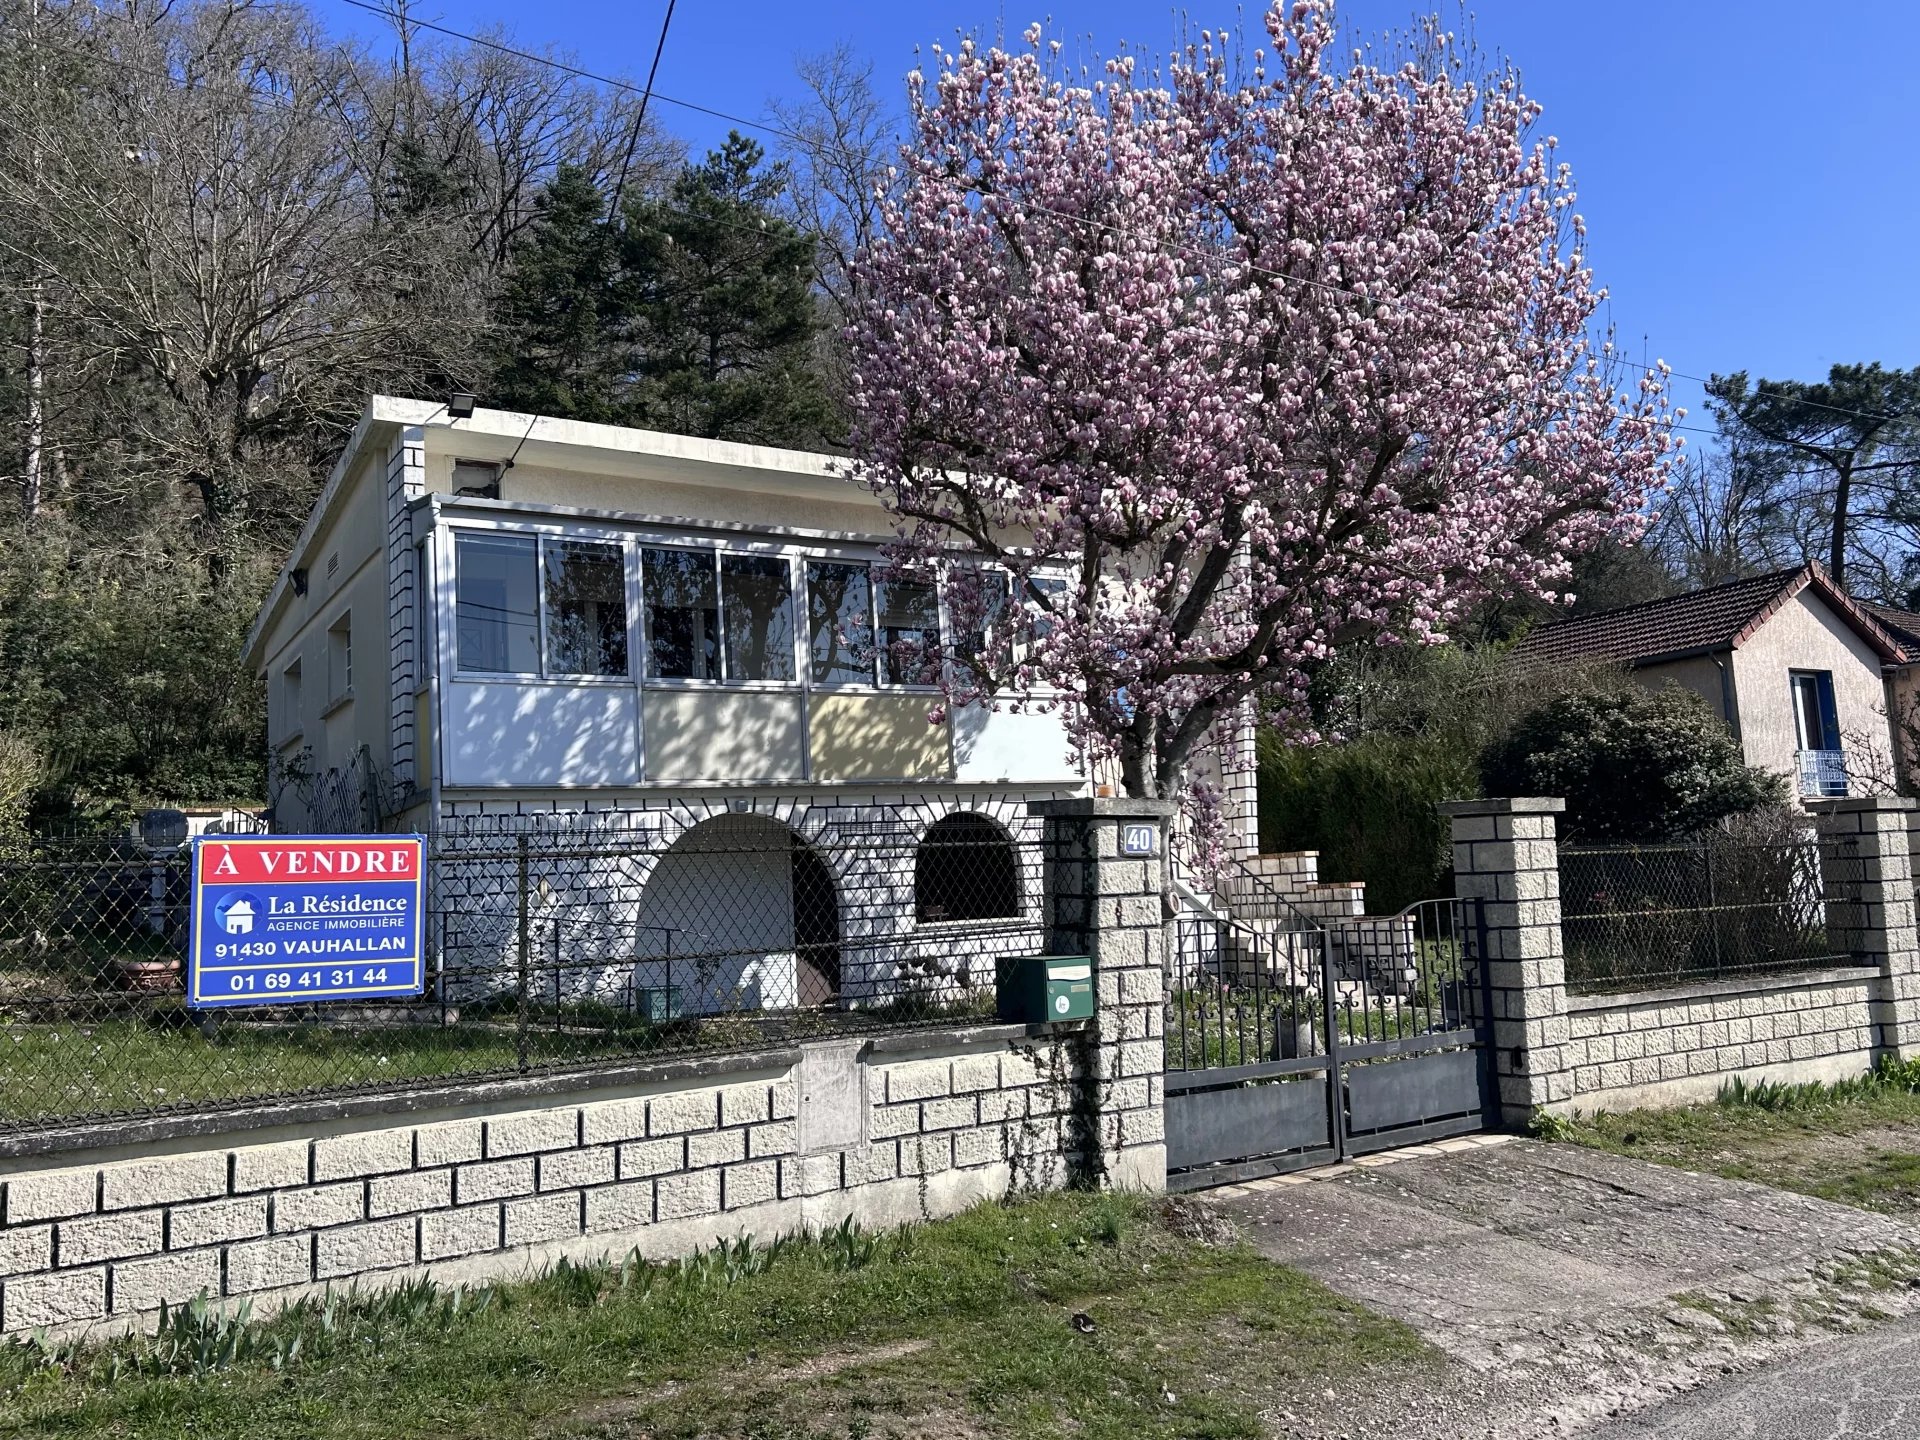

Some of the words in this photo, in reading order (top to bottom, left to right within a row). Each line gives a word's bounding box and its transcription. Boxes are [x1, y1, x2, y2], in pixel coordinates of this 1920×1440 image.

[1127, 828, 1150, 850] 40
[213, 844, 240, 875] À
[258, 850, 410, 875] VENDRE
[268, 896, 297, 915] La
[302, 893, 408, 914] Résidence
[266, 920, 320, 932] AGENCE
[324, 916, 405, 930] IMMOBILIÈRE
[215, 941, 277, 958] 91430
[283, 936, 406, 955] VAUHALLAN
[230, 974, 255, 991] 01
[264, 972, 291, 989] 69
[298, 971, 321, 987] 41
[331, 969, 354, 986] 31
[362, 967, 388, 984] 44
